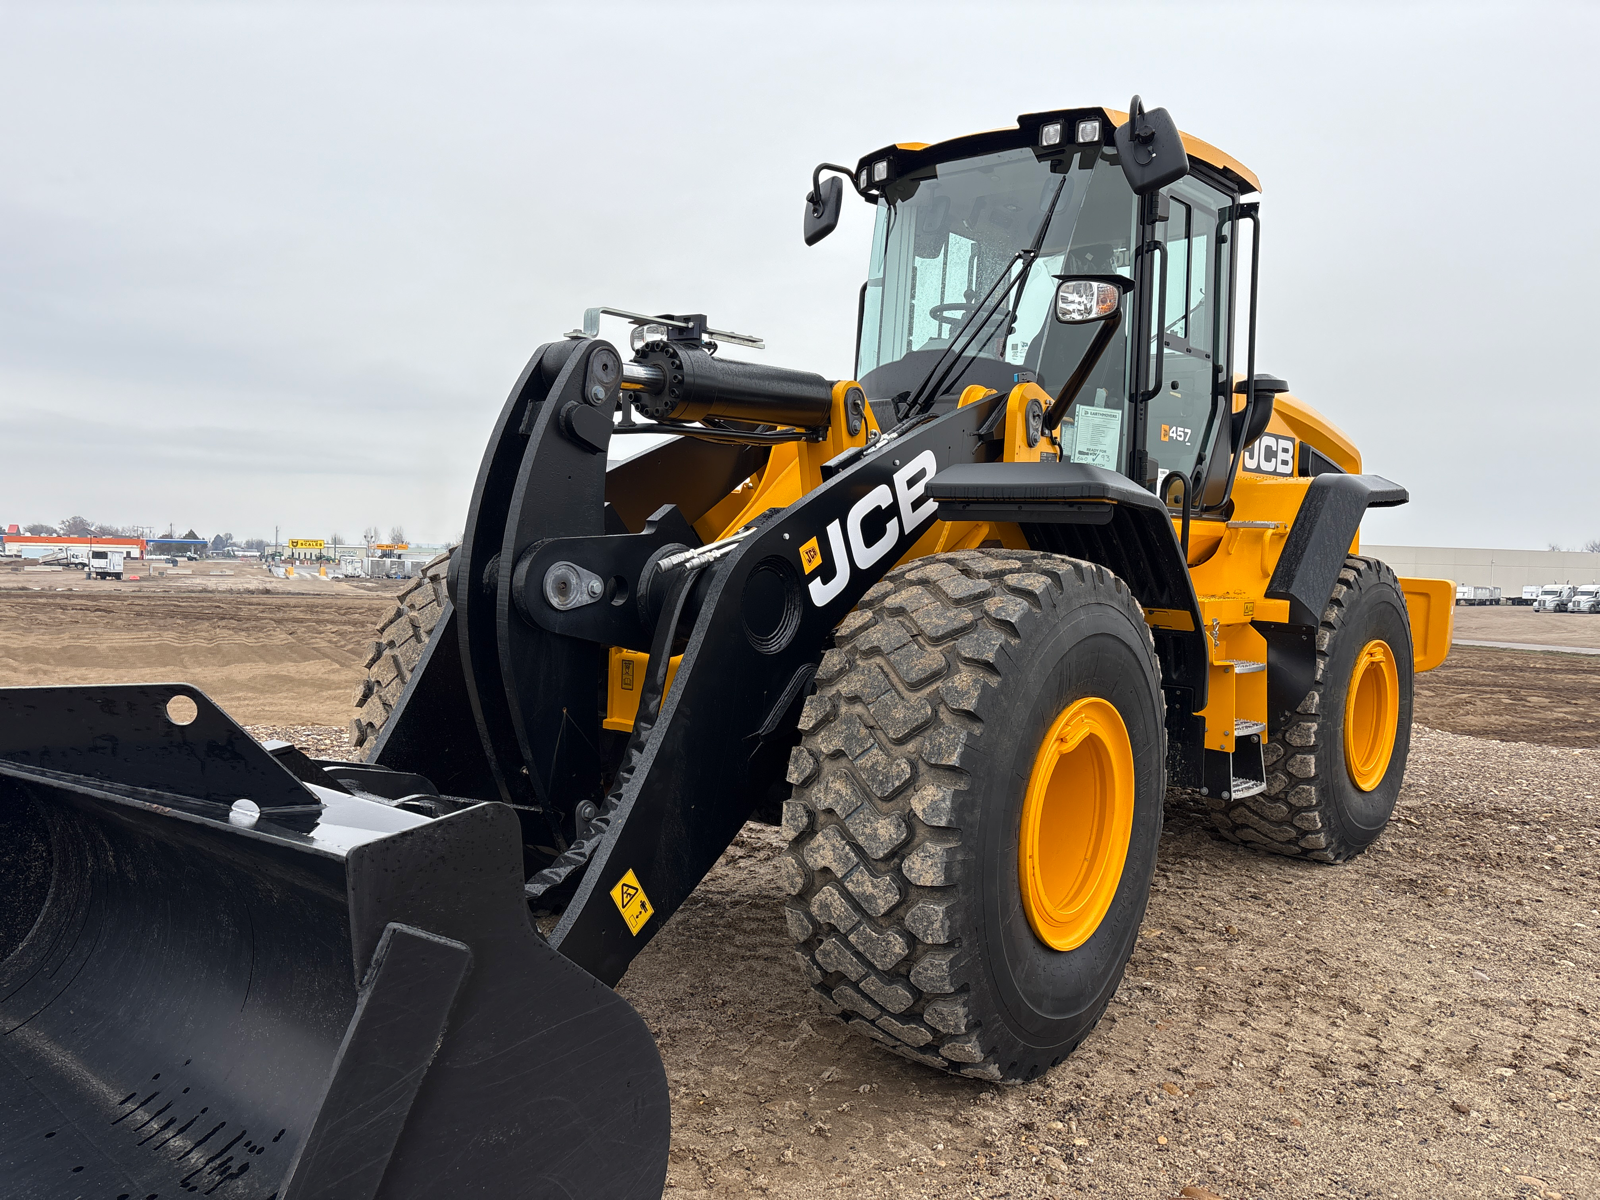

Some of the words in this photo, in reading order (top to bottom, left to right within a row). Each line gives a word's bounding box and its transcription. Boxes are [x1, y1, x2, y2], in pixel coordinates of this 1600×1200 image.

[1169, 426, 1192, 442] 457
[1244, 435, 1294, 474] JCB
[808, 449, 939, 607] JCB
